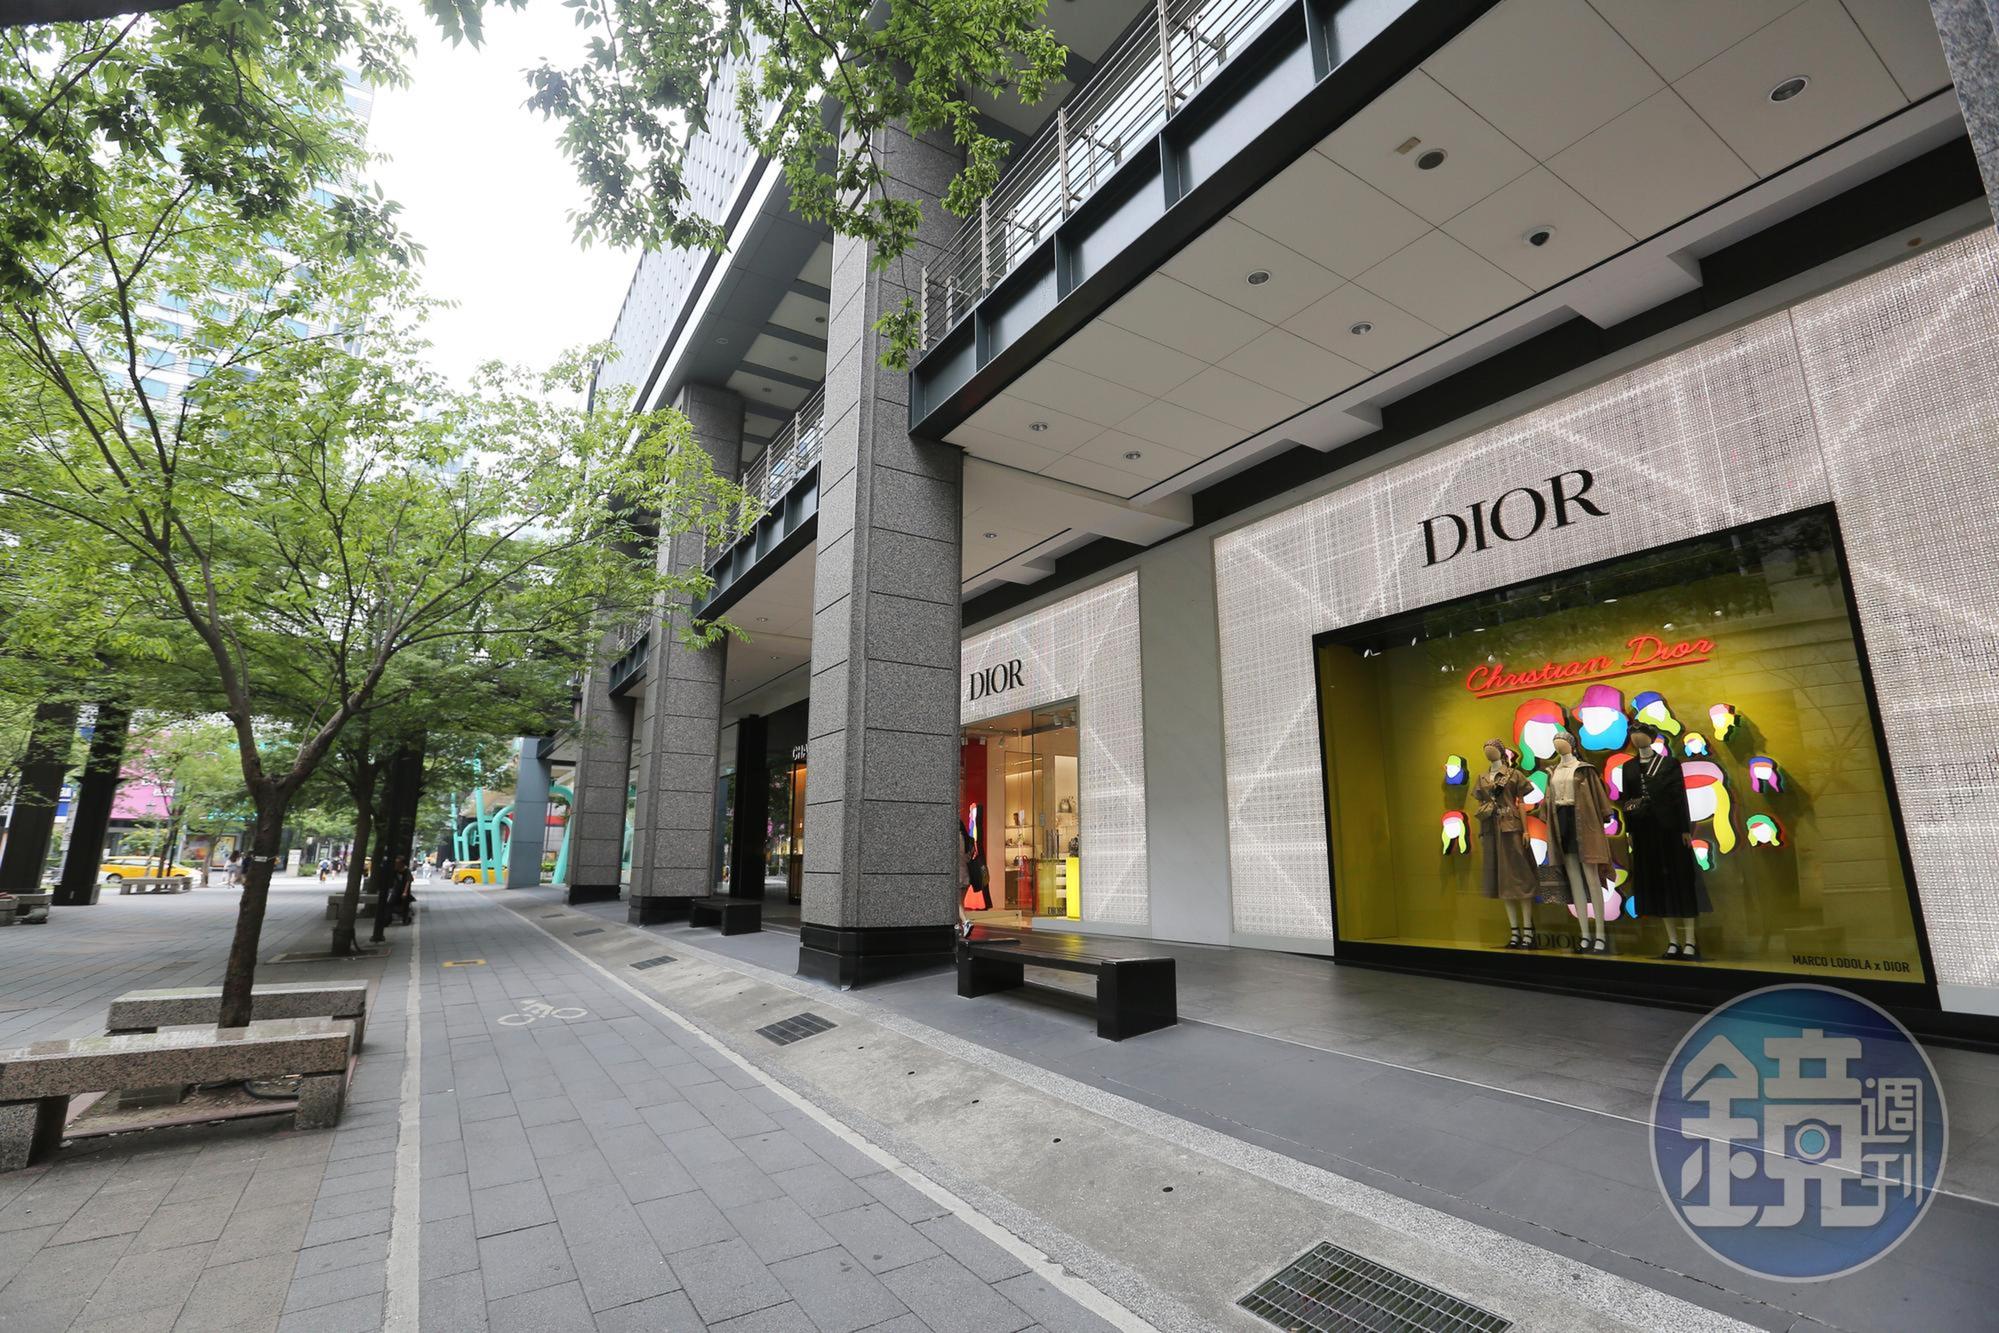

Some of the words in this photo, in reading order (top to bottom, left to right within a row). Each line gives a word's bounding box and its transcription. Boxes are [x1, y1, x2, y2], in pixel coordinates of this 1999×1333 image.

[1417, 468, 1610, 567] DIOR
[969, 659, 1025, 701] DIOR
[1466, 655, 1614, 692] Christian
[1622, 634, 1716, 666] Dior
[1792, 955, 1828, 967] MARCO
[1831, 957, 1871, 970] LODOLA
[1883, 960, 1910, 973] DIOR
